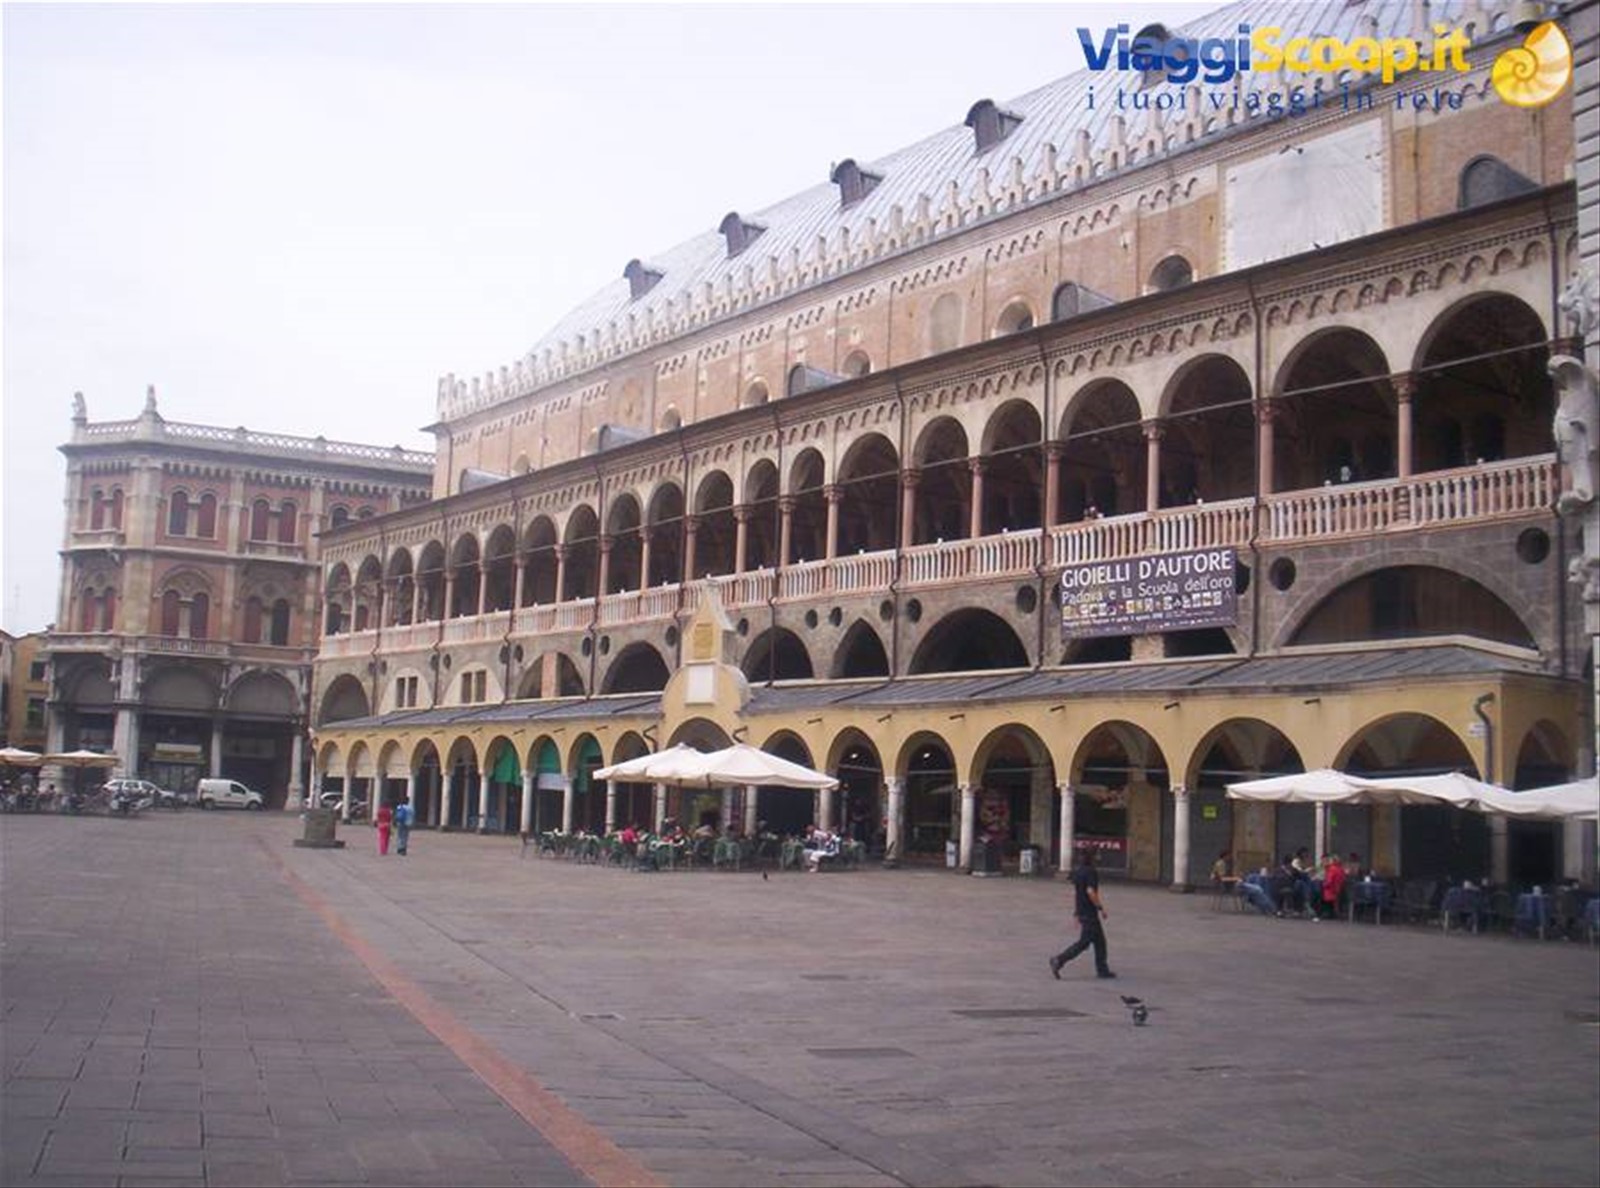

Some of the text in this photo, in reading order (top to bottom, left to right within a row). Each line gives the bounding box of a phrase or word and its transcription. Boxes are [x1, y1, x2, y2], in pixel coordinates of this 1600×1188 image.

[1062, 550, 1232, 588] GIOIELLI D'AUTORE
[1062, 590, 1103, 605] Padova
[1122, 586, 1133, 598] la
[1138, 582, 1179, 598] Scuola
[1184, 576, 1232, 593] dell'oro
